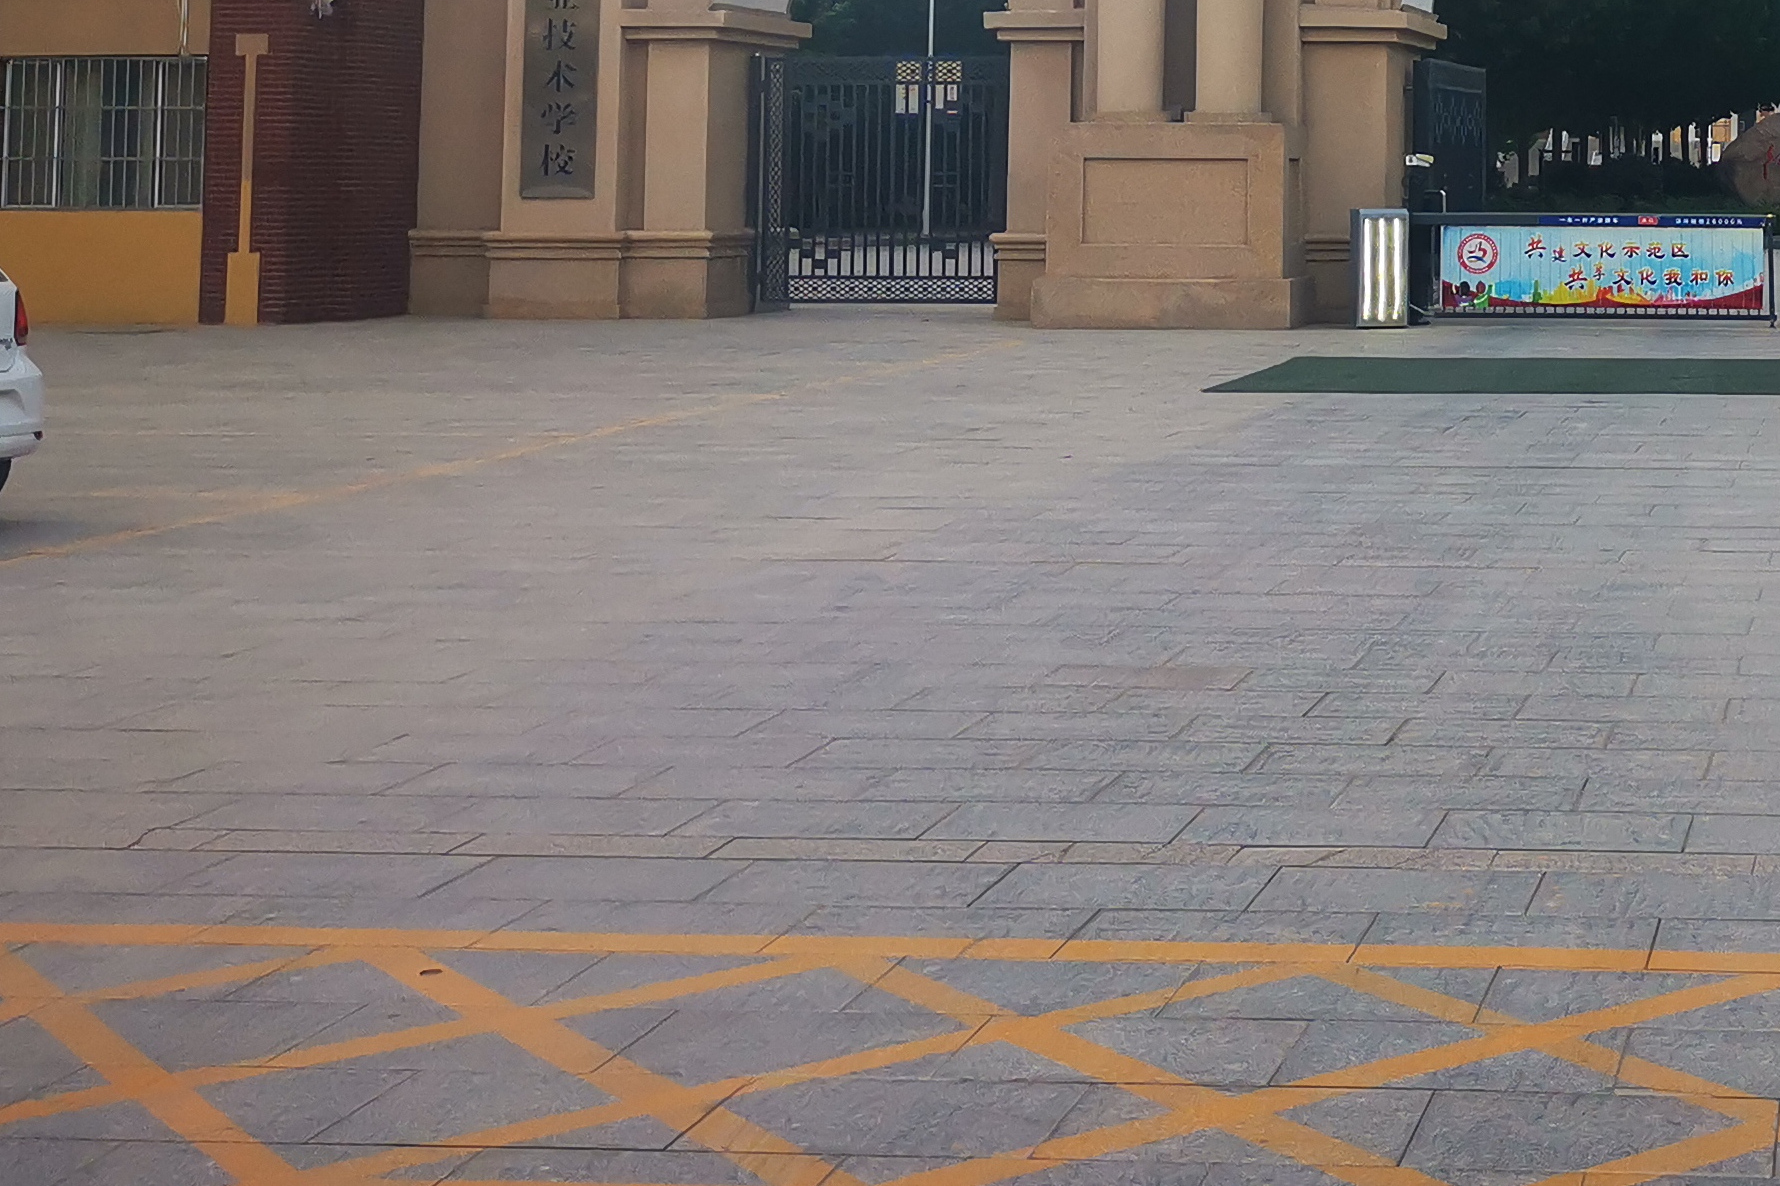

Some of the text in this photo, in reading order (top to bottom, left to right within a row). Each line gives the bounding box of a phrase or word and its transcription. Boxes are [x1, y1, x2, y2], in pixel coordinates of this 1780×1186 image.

[1524, 233, 1690, 263] 共建文化示范区
[1564, 262, 1735, 291] 共享文化我和你
